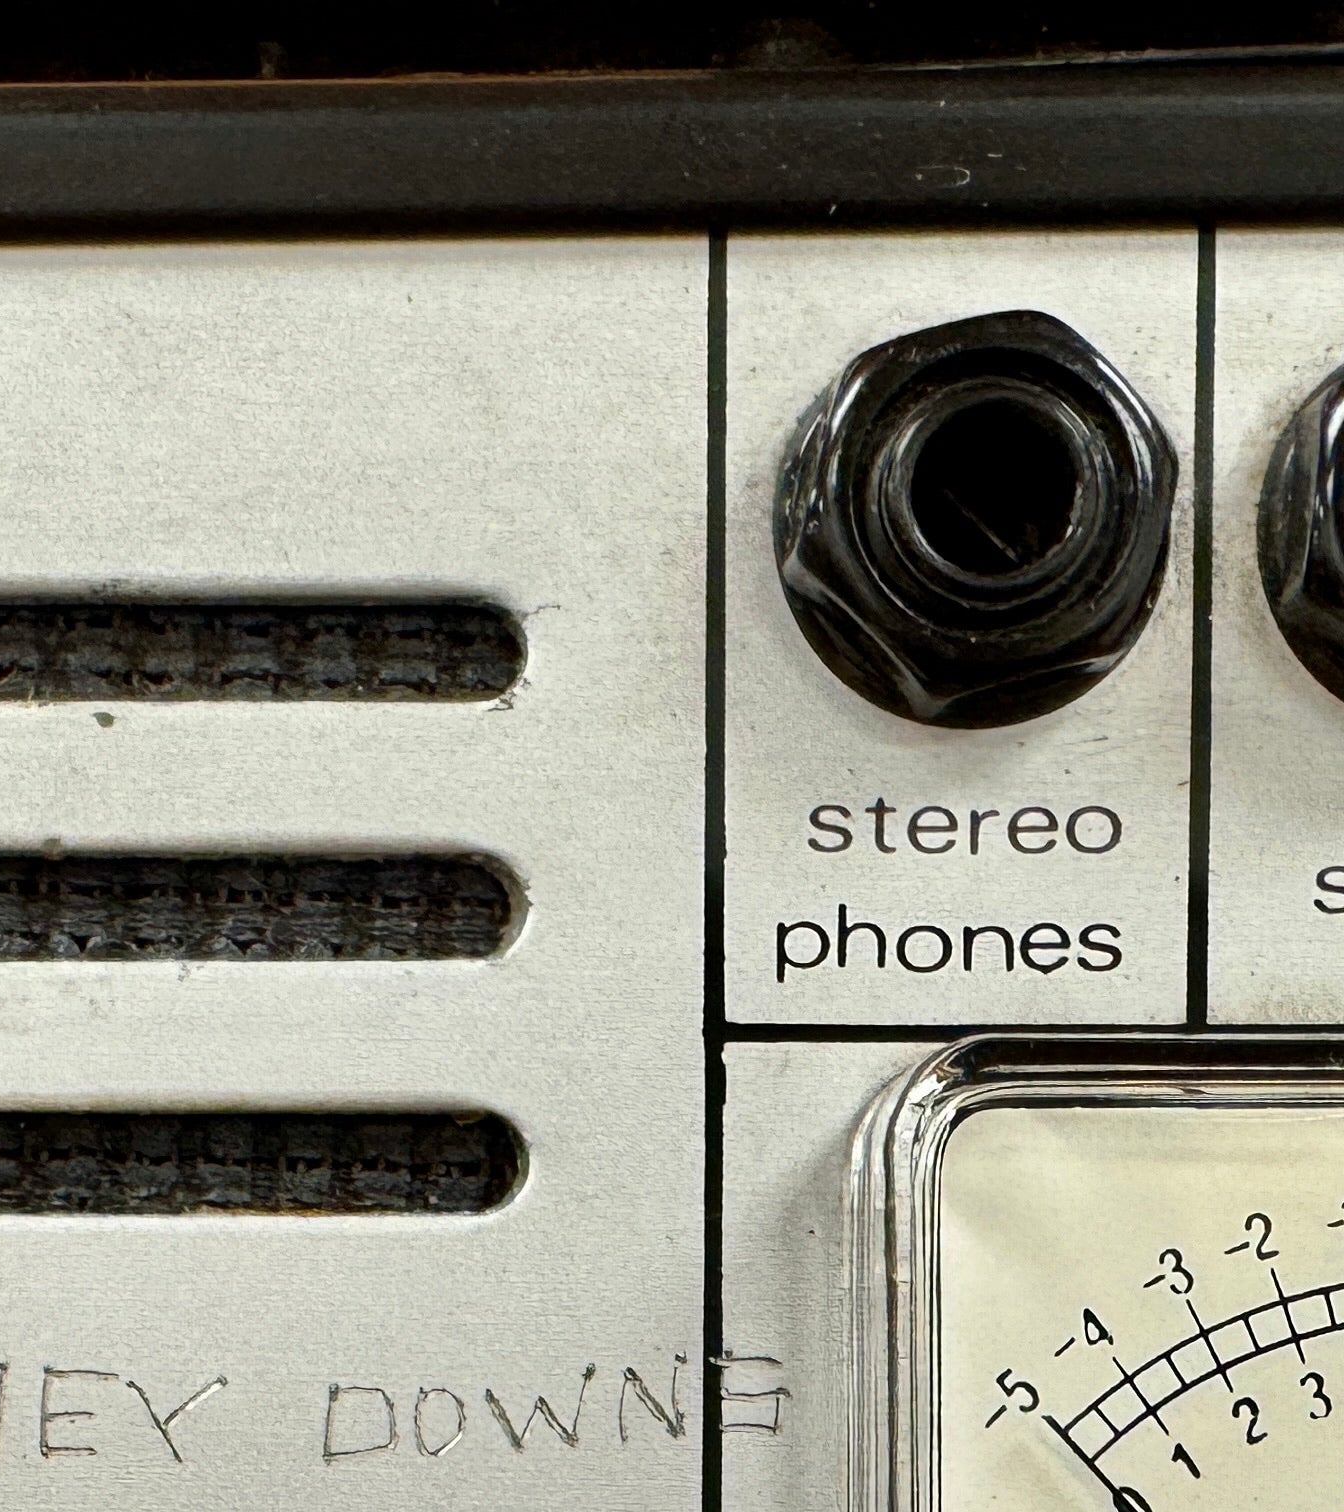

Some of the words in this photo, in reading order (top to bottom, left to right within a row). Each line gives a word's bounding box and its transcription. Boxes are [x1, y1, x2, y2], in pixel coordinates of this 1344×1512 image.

[807, 796, 1123, 856] stereo
[776, 903, 1123, 984] phones
[984, 1368, 1040, 1429] -5
[1054, 1308, 1114, 1358] -4
[1142, 1248, 1194, 1295] -3
[1223, 1212, 1280, 1261] -2
[322, 1349, 793, 1466] DOWNS
[1171, 1442, 1201, 1480] 1
[1231, 1396, 1264, 1446] 2
[1299, 1371, 1333, 1420] 3
